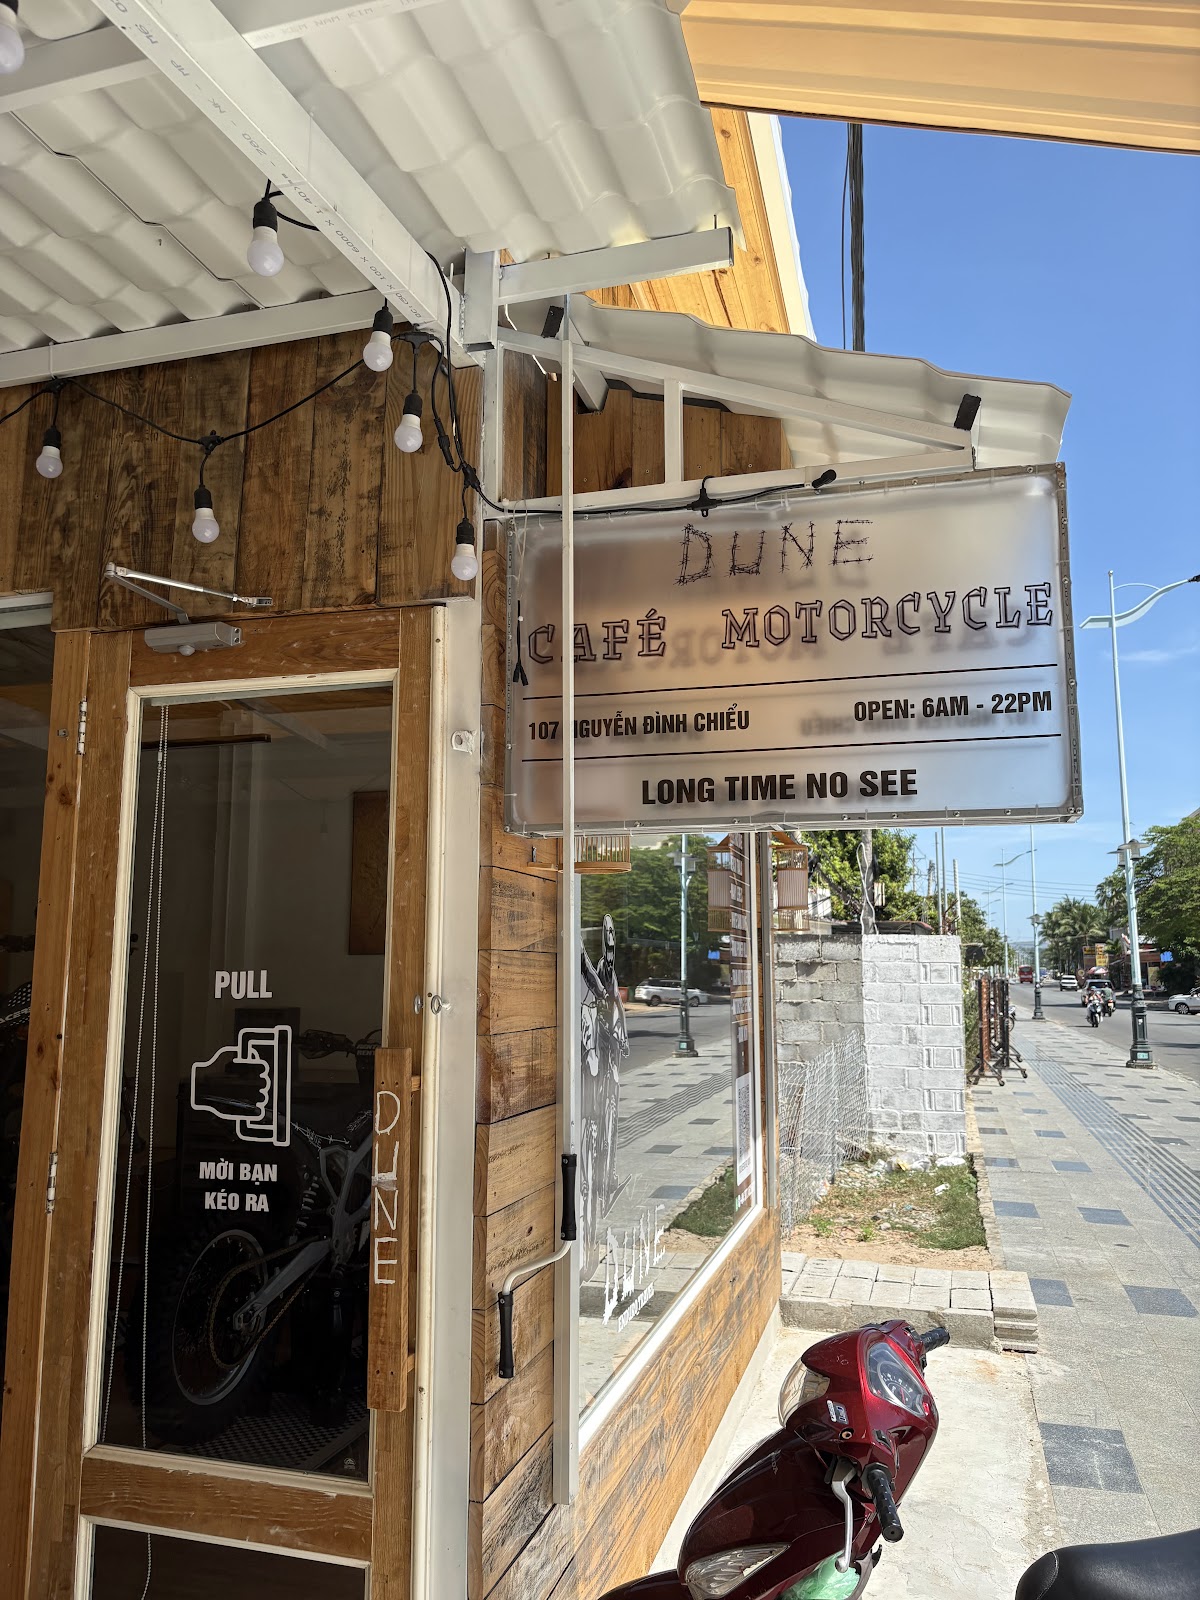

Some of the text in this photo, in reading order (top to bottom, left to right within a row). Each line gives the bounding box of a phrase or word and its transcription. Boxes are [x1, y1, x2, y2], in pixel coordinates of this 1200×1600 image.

[673, 519, 875, 586] DUNE
[528, 608, 667, 664] CAFÉ
[722, 582, 1053, 650] MOTORCYCLE
[529, 721, 560, 740] 107
[643, 711, 688, 735] ĐÌNH
[694, 703, 750, 732] CHIỂU
[854, 700, 916, 723] OPEN:
[922, 695, 970, 718] 6AM
[991, 690, 1053, 715] 22PM
[642, 768, 918, 805] LONG TIME NO SEE
[214, 969, 273, 1000] PULL
[199, 1157, 278, 1186] MỜI BẠN
[373, 1089, 402, 1285] DUNE
[204, 1189, 270, 1213] KÉO RA
